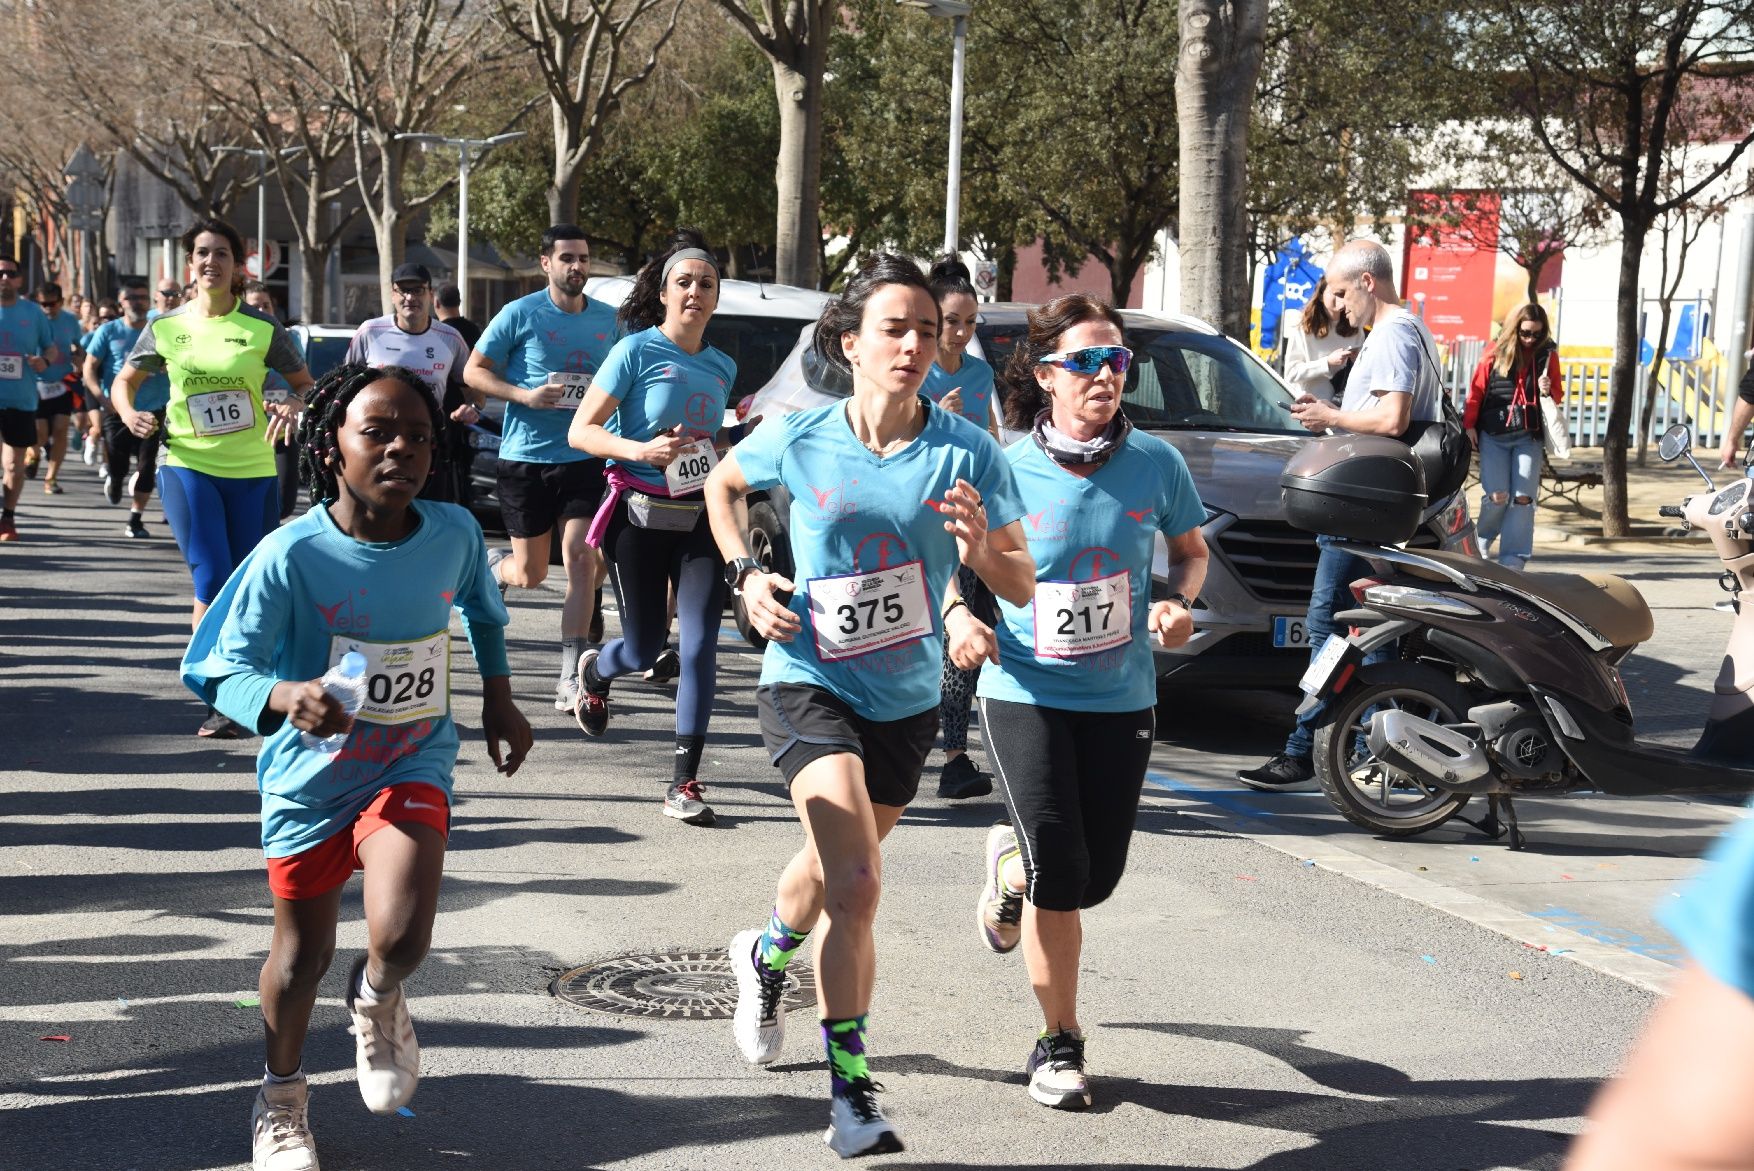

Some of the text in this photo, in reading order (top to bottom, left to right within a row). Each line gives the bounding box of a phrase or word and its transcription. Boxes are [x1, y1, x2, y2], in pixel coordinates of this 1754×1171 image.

[204, 404, 240, 424] 116
[678, 455, 710, 479] 408
[837, 593, 904, 635] 375
[1056, 601, 1114, 635] 217
